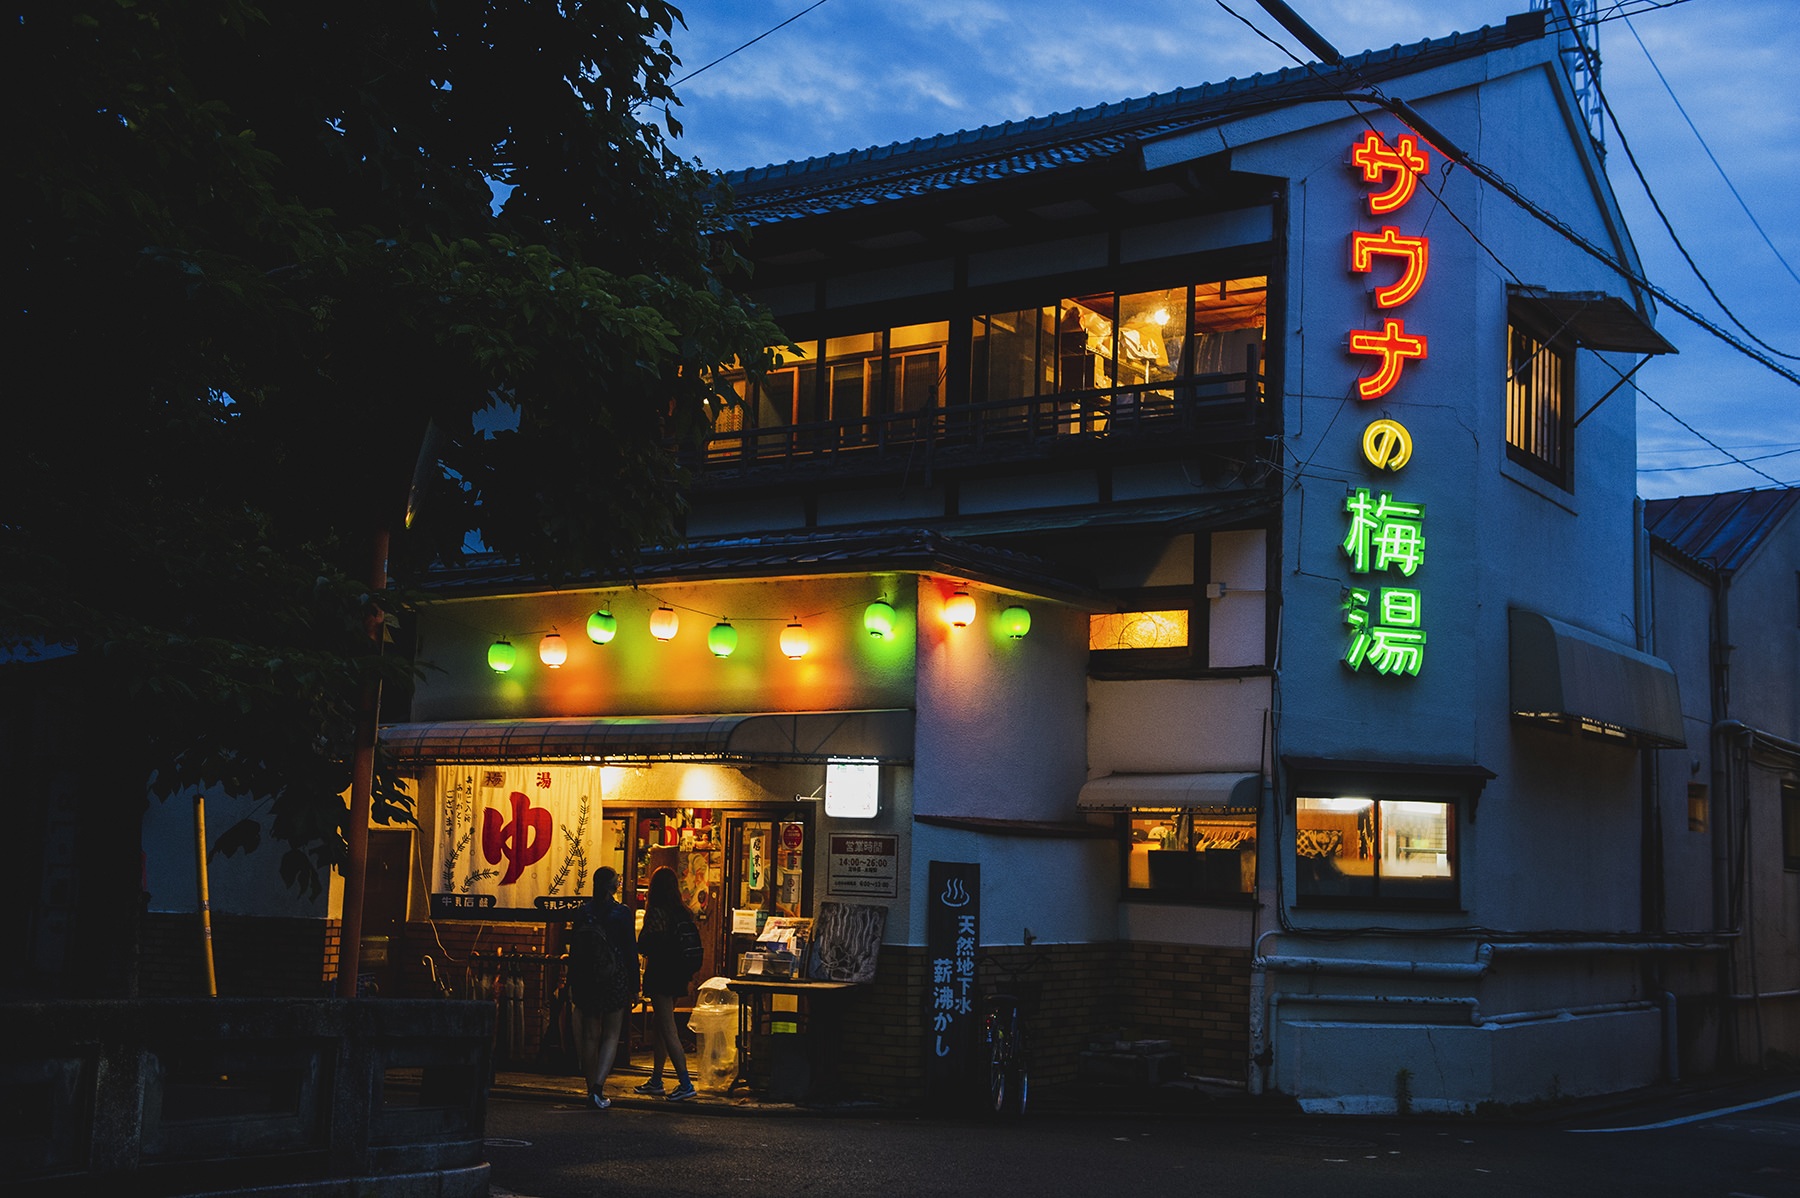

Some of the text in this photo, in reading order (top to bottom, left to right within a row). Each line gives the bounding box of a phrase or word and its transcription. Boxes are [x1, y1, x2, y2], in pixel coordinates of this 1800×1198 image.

[1340, 130, 1429, 677] サウナの梅湯
[445, 789, 455, 838] ございます
[536, 772, 552, 789] 湯
[482, 791, 553, 886] ゆ
[845, 841, 883, 853] 営業時間
[933, 958, 953, 1056] 薪沸かし
[955, 915, 975, 1015] 天然地下水
